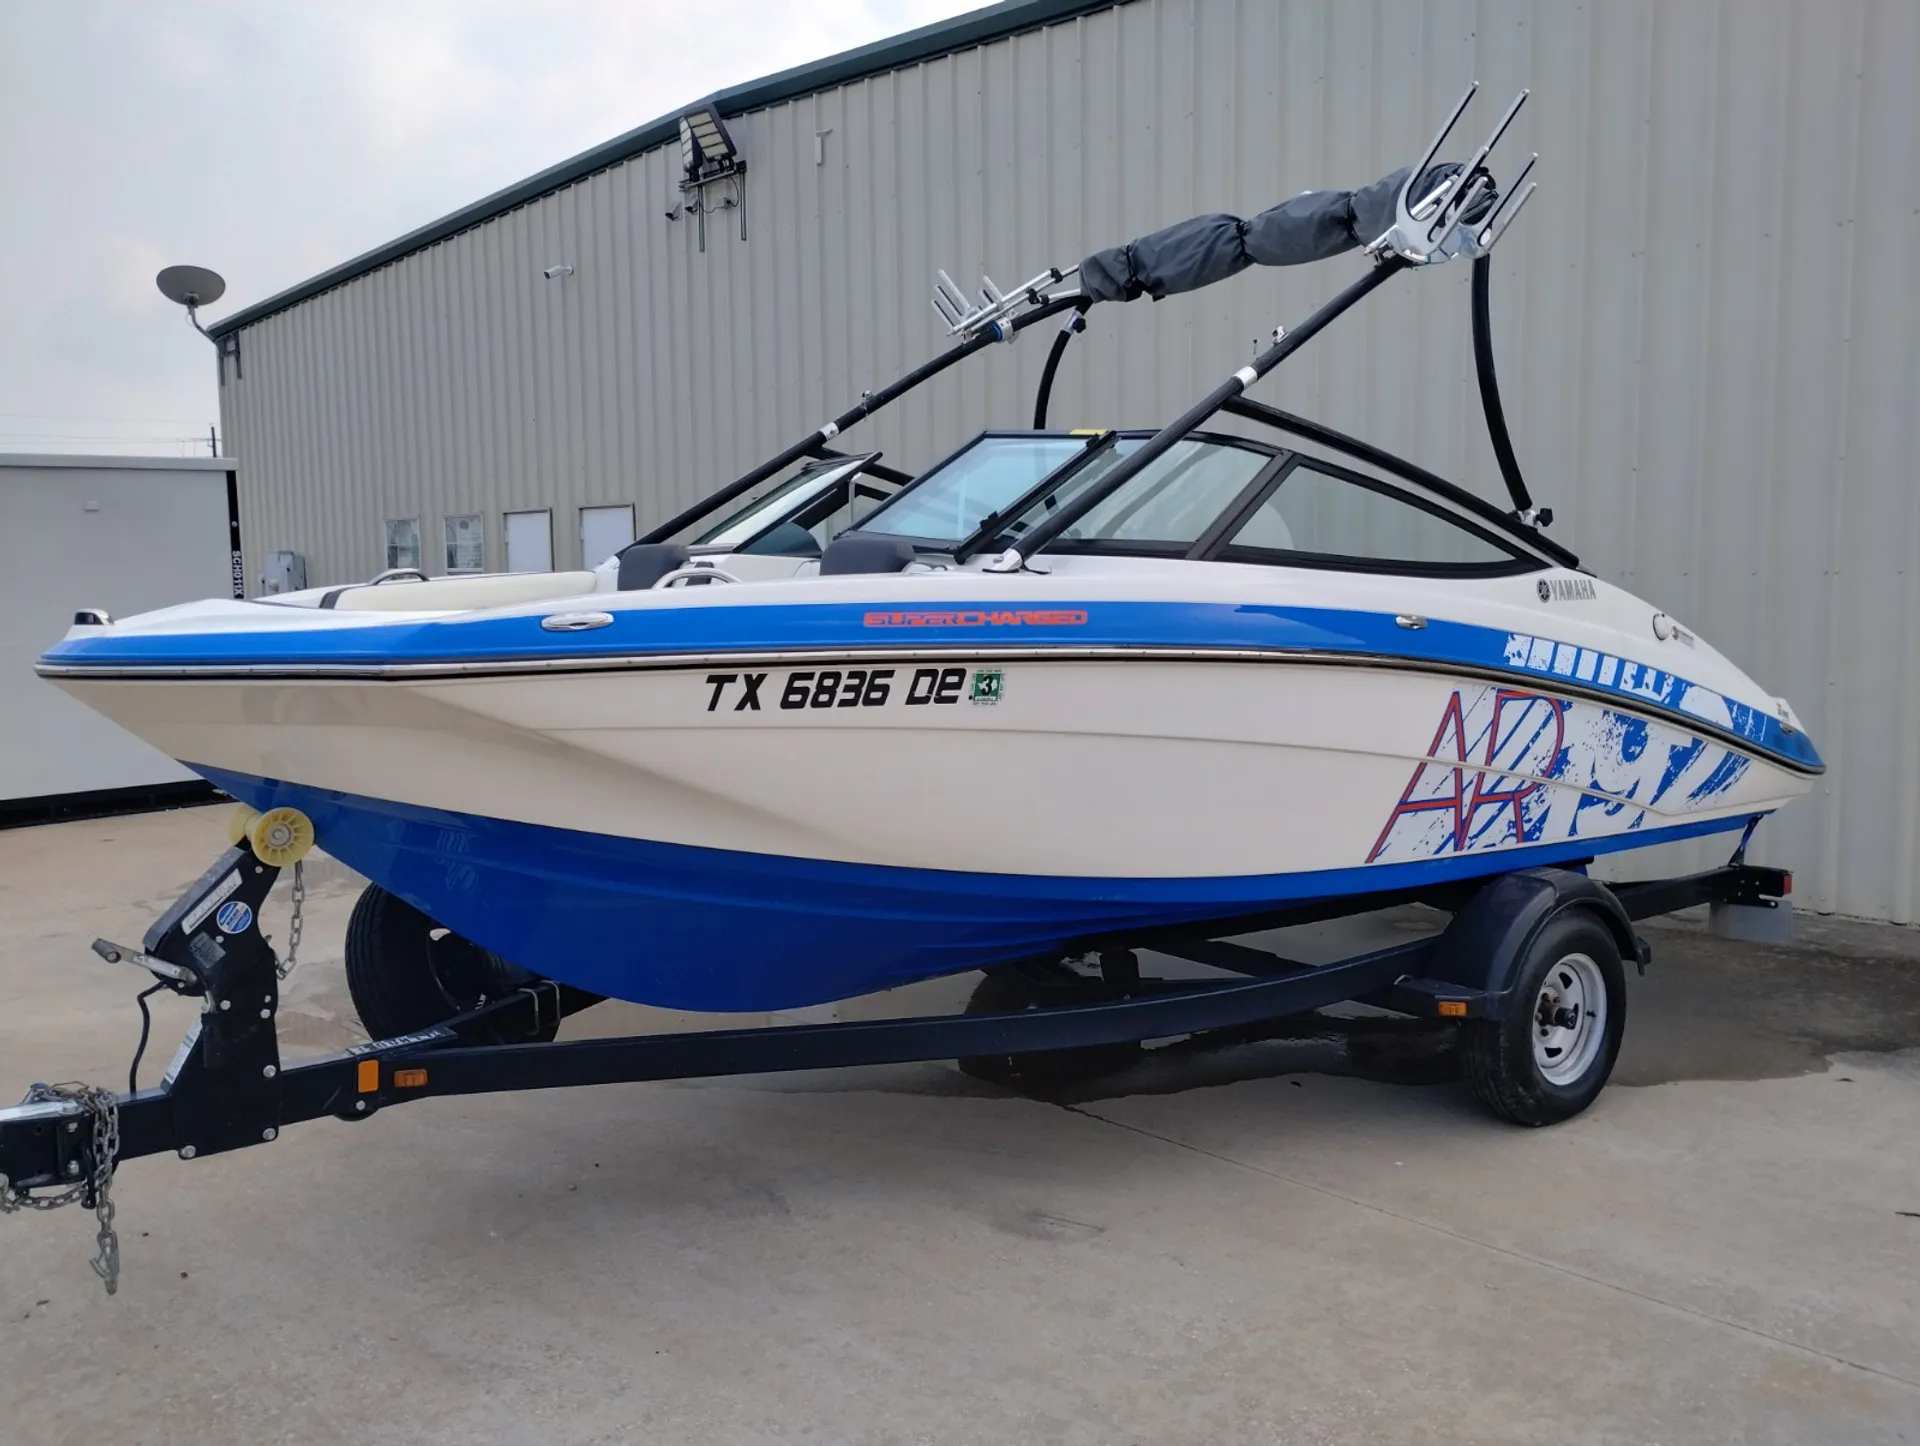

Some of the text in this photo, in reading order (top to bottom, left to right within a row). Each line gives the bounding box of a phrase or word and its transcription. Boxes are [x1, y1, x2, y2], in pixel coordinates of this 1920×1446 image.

[1549, 579, 1597, 601] YAMAHA
[863, 611, 1089, 627] SUPERCHARGED
[706, 673, 768, 711] TX
[780, 669, 895, 709] 6836
[981, 674, 994, 696] 3
